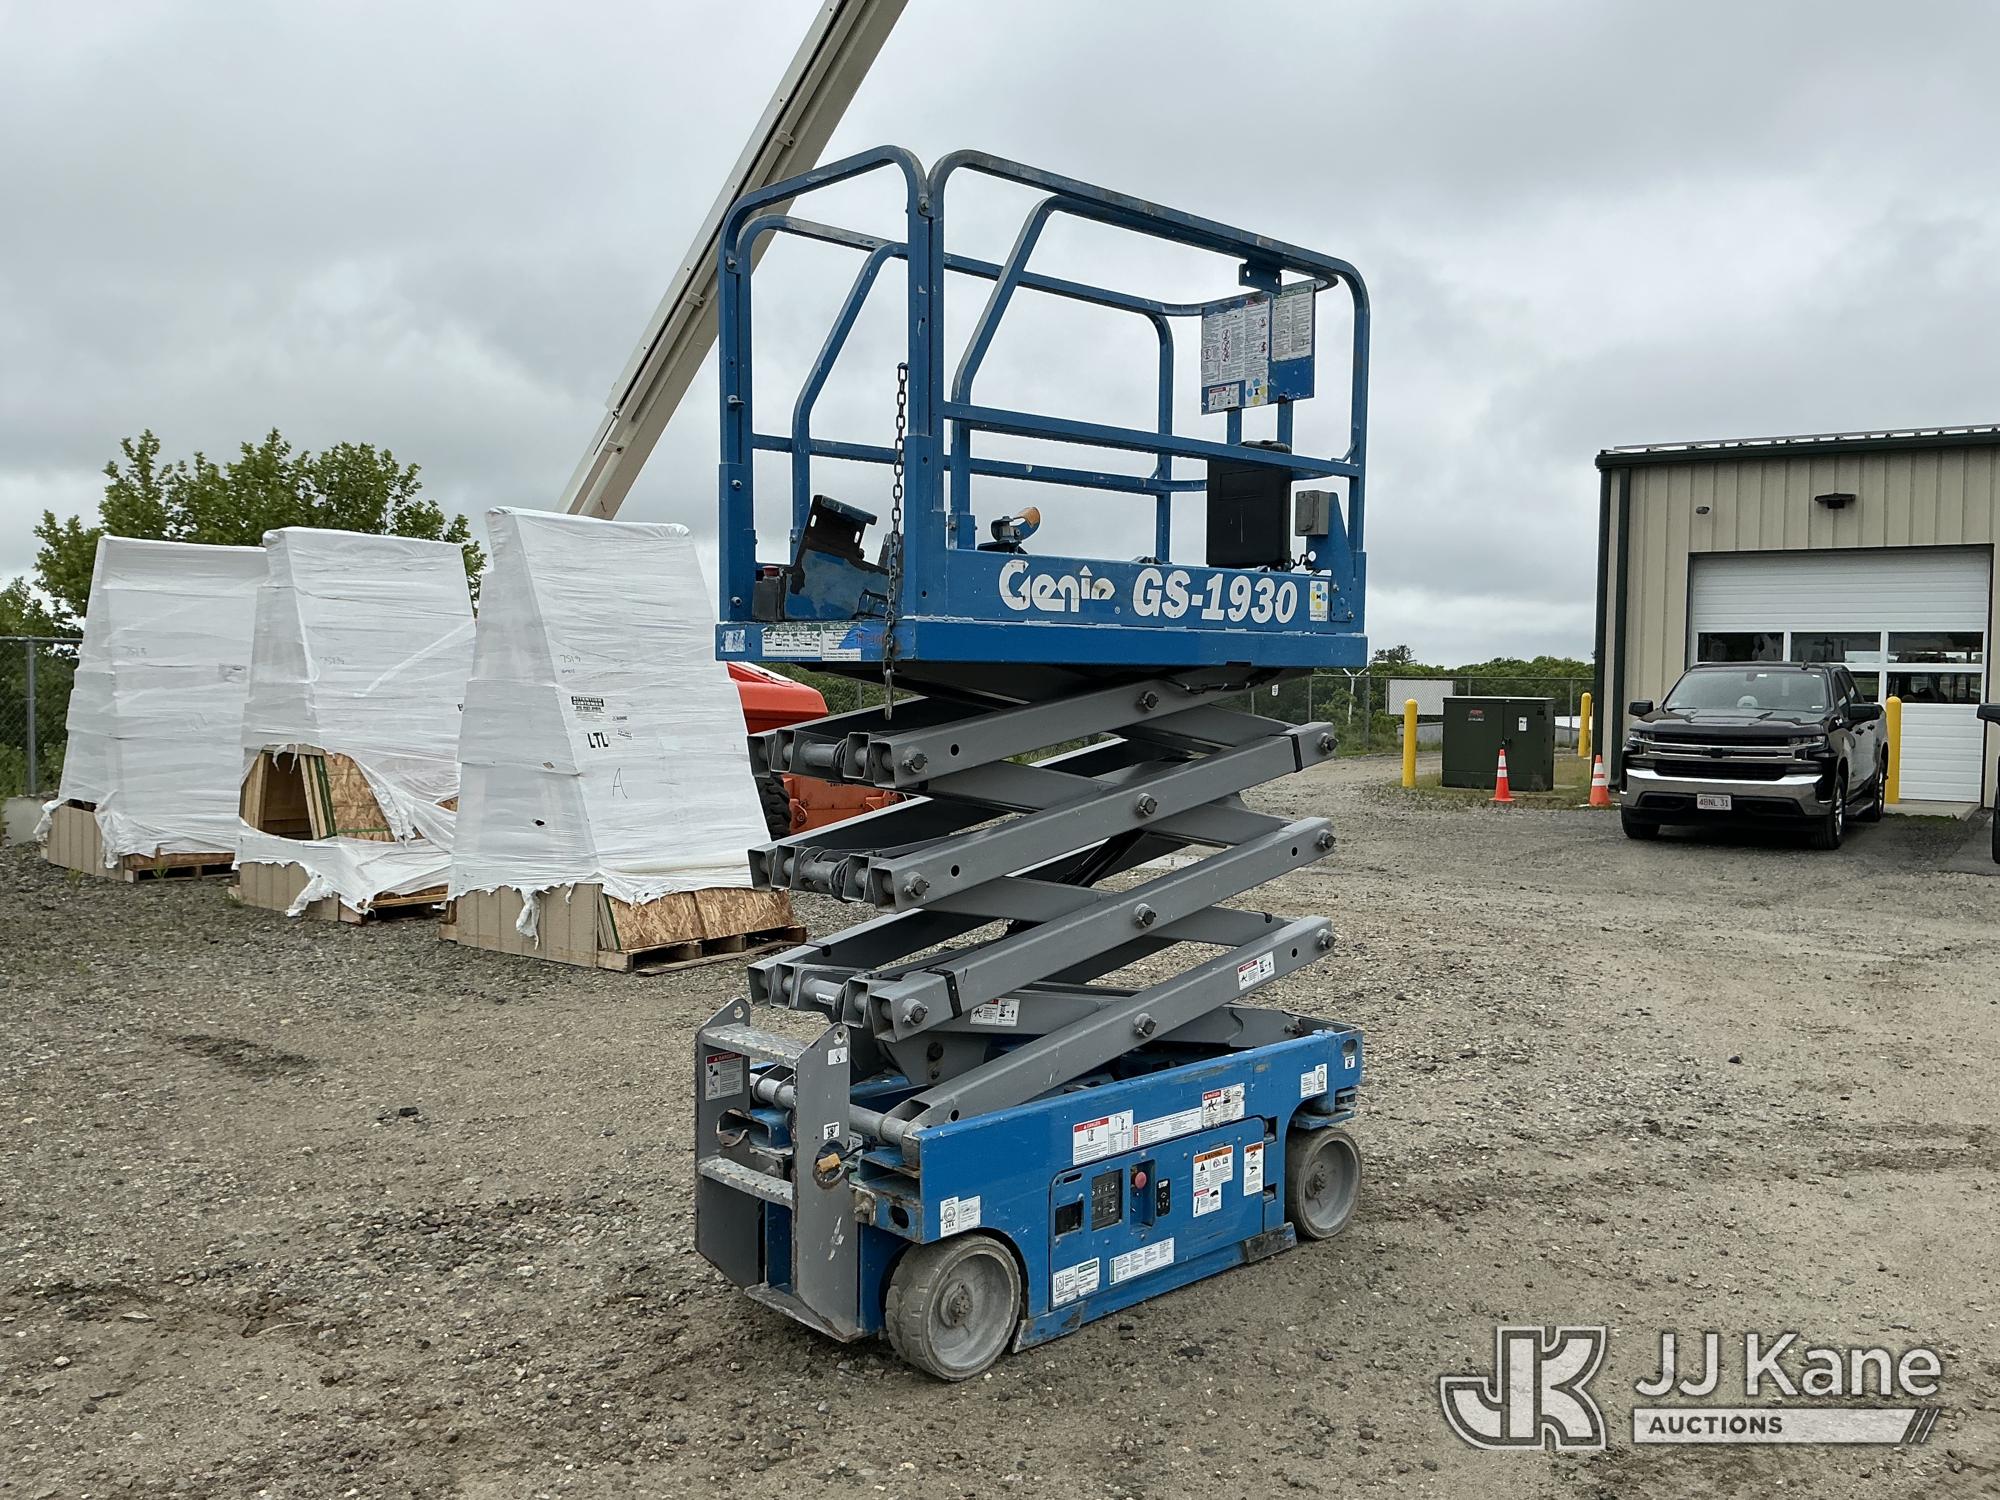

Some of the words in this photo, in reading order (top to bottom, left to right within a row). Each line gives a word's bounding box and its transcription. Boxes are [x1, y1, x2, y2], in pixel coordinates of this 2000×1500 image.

[999, 559, 1116, 613] Genie
[1133, 567, 1298, 625] GS-1930
[587, 731, 609, 749] LTL
[612, 767, 629, 800] A
[1720, 798, 1729, 808] 31
